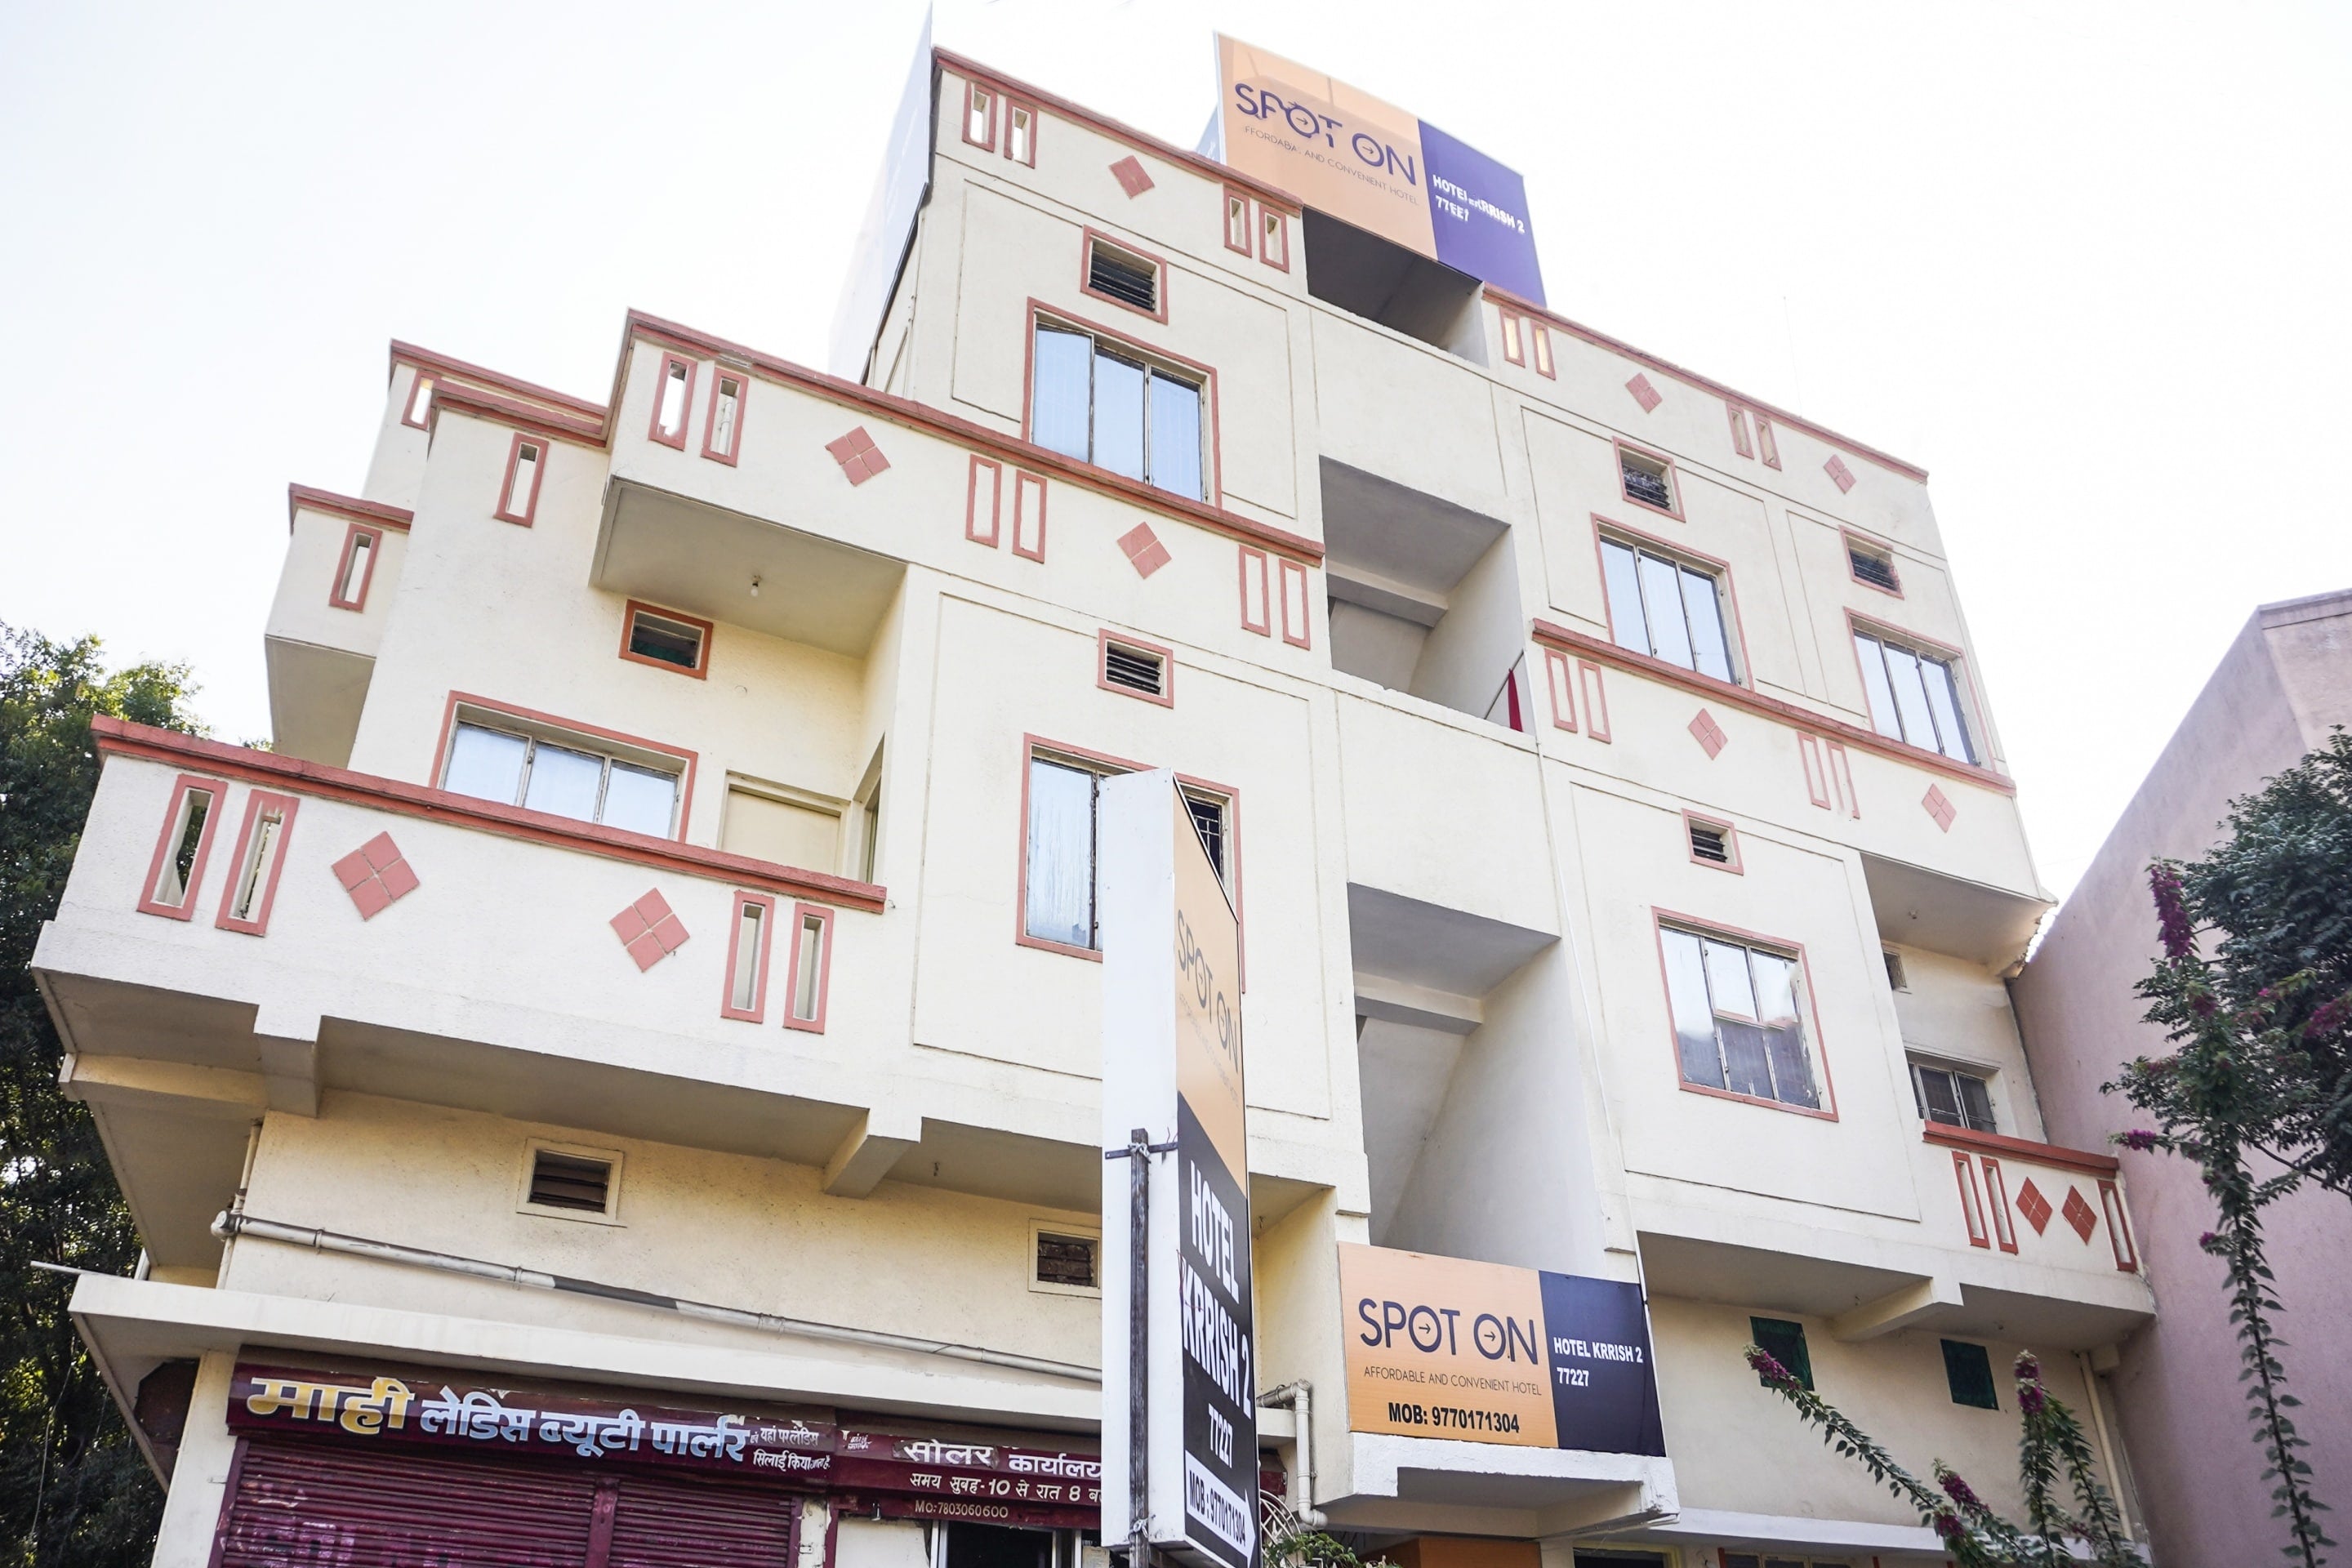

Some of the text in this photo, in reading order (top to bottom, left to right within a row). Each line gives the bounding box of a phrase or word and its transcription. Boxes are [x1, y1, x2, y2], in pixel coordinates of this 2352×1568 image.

[1235, 82, 1417, 186] SPOT ON
[1304, 149, 1325, 163] AND
[1327, 158, 1387, 190] CONVENIENT
[1390, 187, 1418, 204] HOTEL
[1517, 219, 1526, 234] 2
[1178, 909, 1214, 1024] SPOT
[1216, 991, 1239, 1074] ON
[1190, 1159, 1240, 1305] HOTEL
[1182, 1257, 1252, 1420] KRRISH 2
[1358, 1298, 1539, 1365] SPOT ON
[1553, 1337, 1644, 1363] HOTEL KRRISH 2
[1364, 1366, 1542, 1396] AFFORDABLE AND CONVENIENT HOTEL
[1557, 1367, 1589, 1387] 77227
[247, 1375, 415, 1435] माही
[420, 1385, 537, 1442] लेडिस
[538, 1408, 645, 1458] ब्यूटी
[1208, 1402, 1233, 1468] 77227
[1388, 1402, 1520, 1433] MOB: 9770171304
[903, 1439, 994, 1465] सोलर
[910, 1472, 942, 1489] समय
[1016, 1479, 1030, 1497] से
[1036, 1484, 1062, 1500] रात
[1068, 1485, 1081, 1502] 8
[1210, 1487, 1246, 1547] 9770171304
